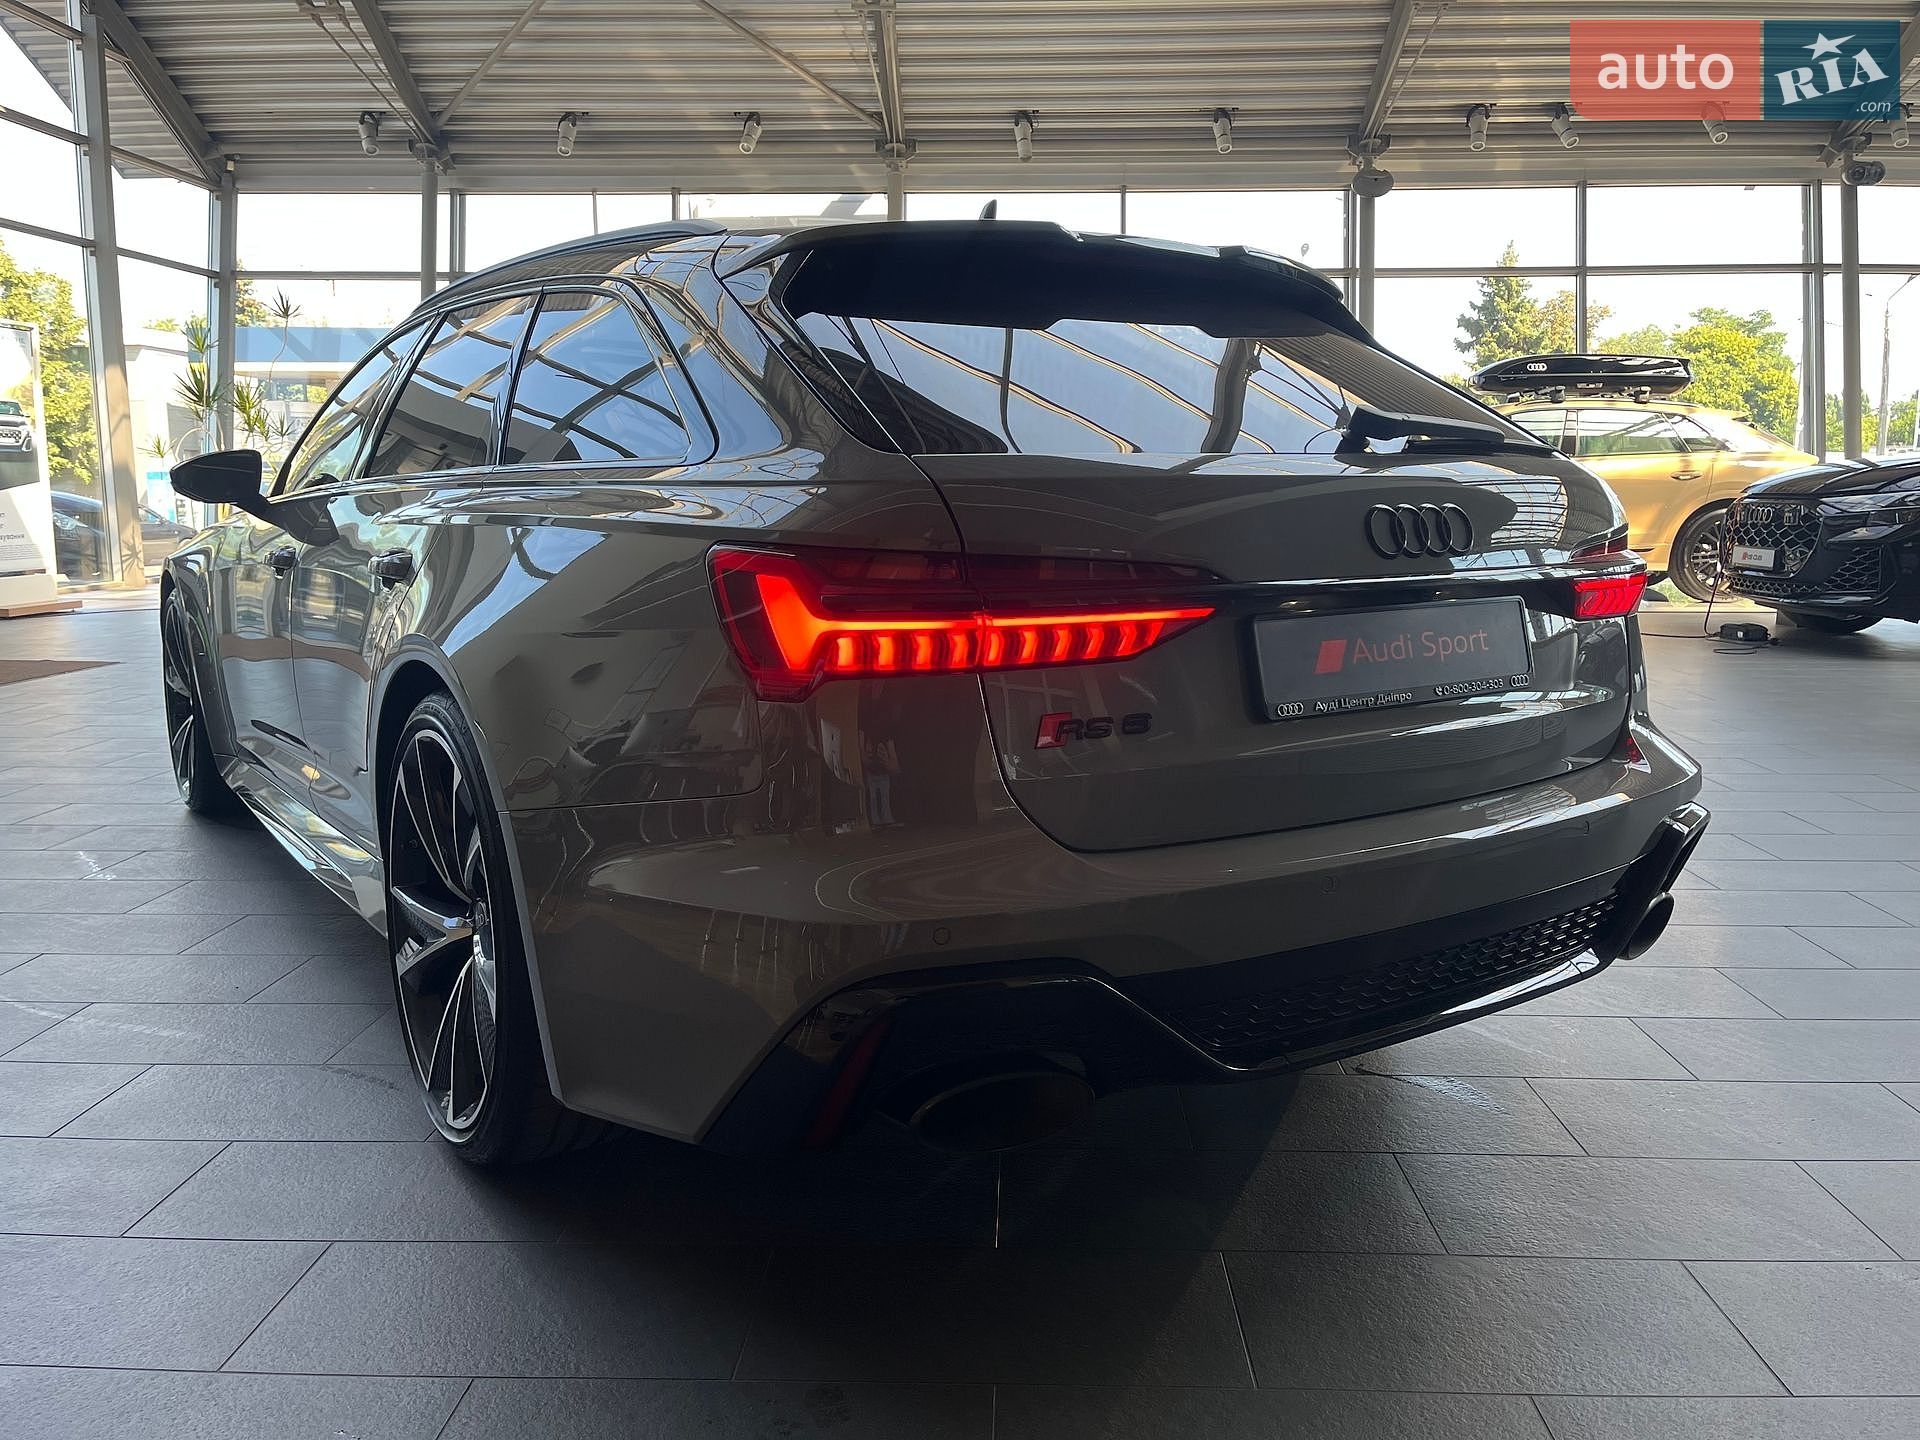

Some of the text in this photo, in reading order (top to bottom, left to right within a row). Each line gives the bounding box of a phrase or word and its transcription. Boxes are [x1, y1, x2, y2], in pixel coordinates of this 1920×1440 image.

[1353, 629, 1490, 665] Audi Sport
[1315, 691, 1413, 713] Ауді Центр Дніпро
[1056, 712, 1153, 741] RS 6
